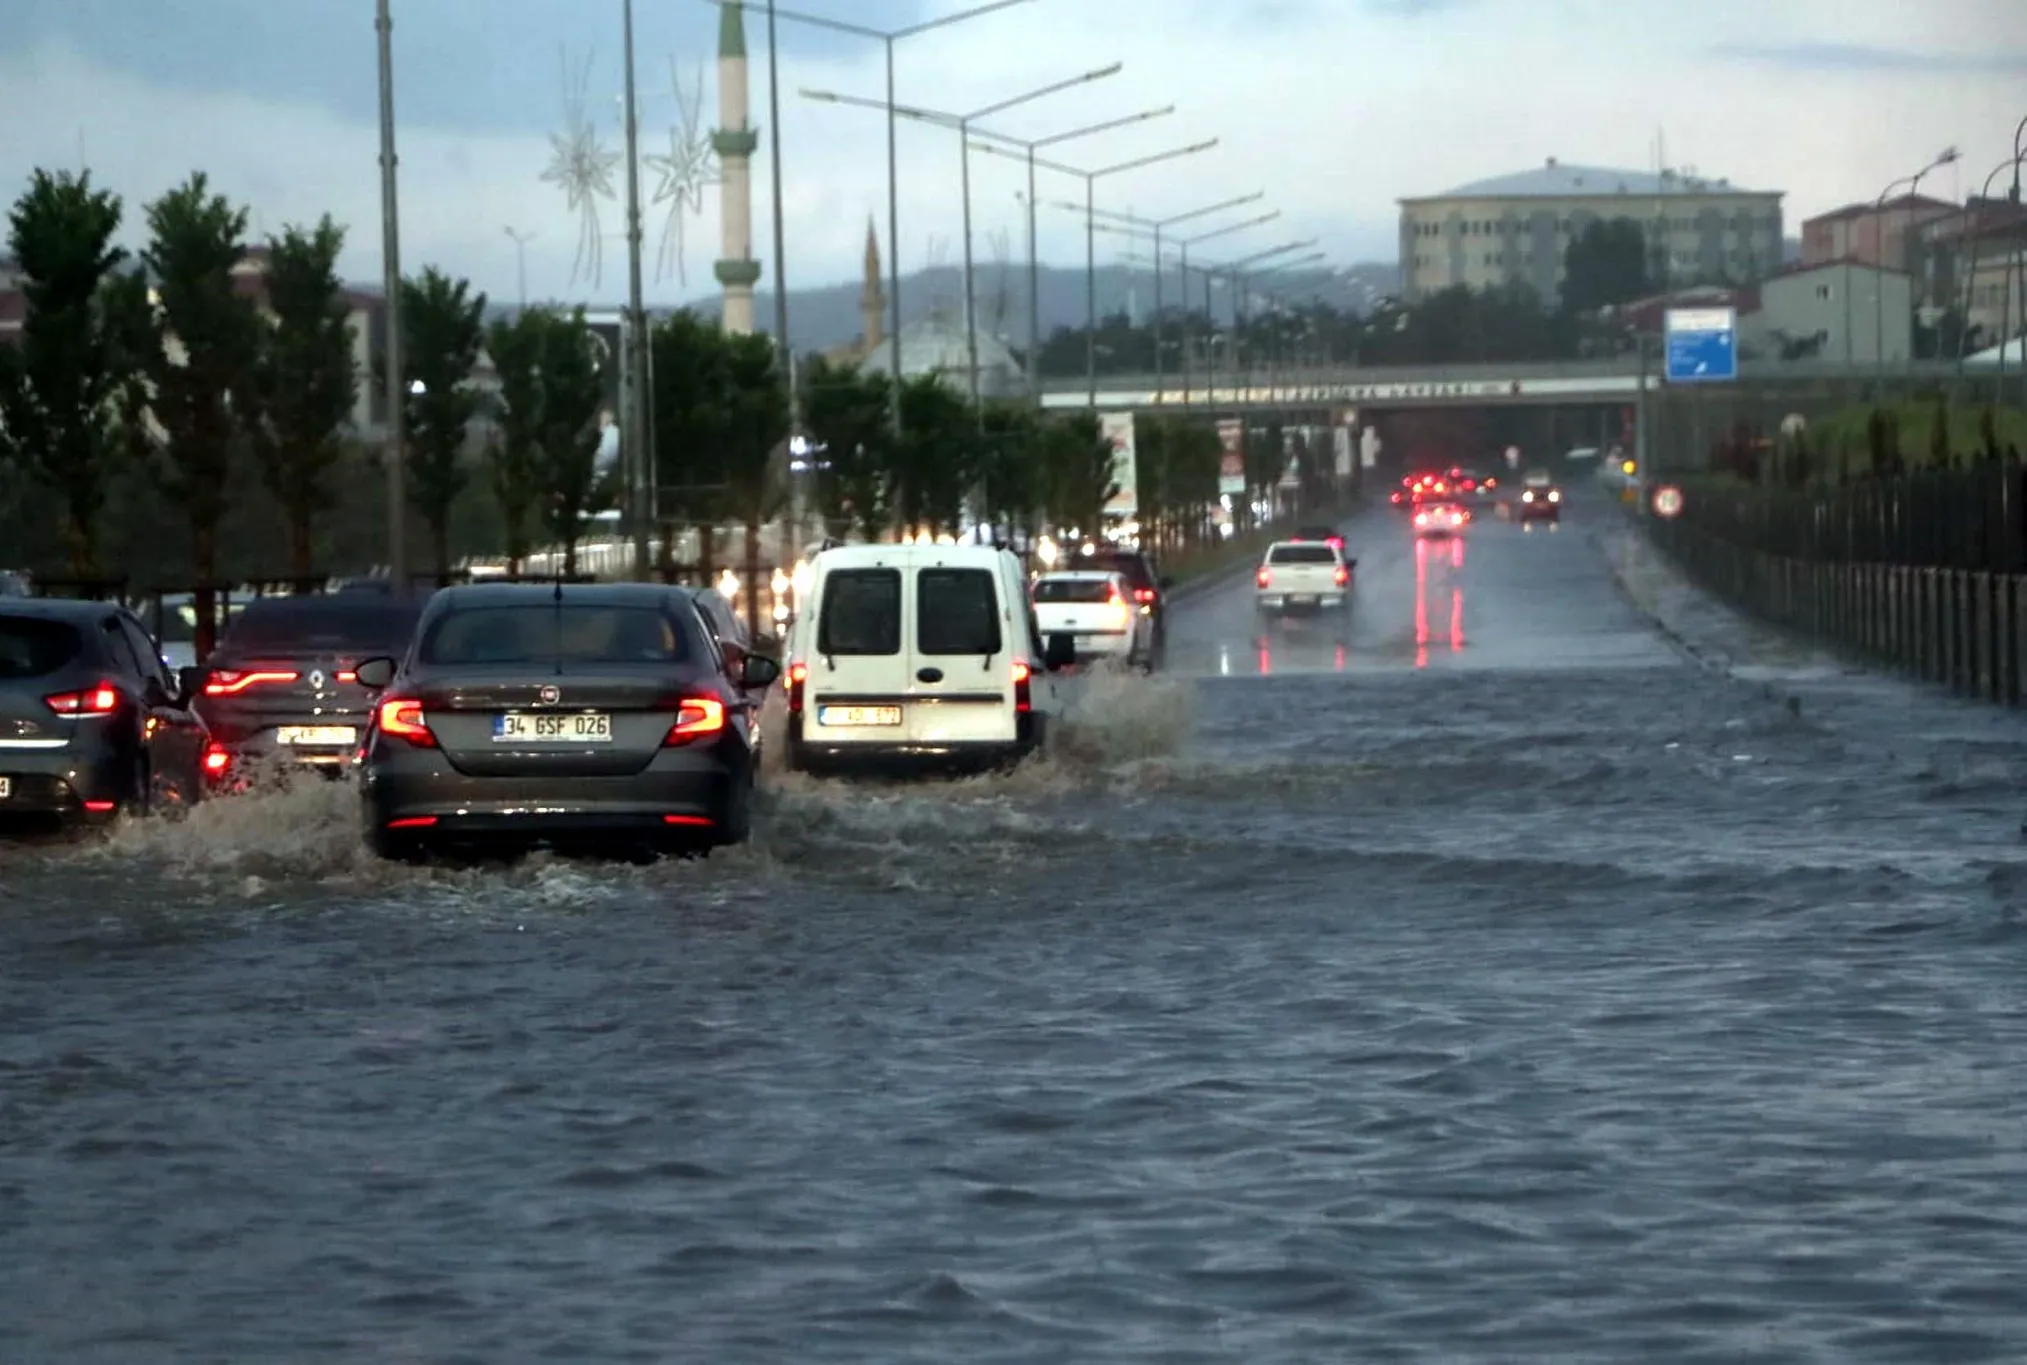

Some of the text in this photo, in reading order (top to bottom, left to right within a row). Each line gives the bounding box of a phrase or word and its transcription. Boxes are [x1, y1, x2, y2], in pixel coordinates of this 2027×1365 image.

[505, 716, 607, 735] 34 GSF 026
